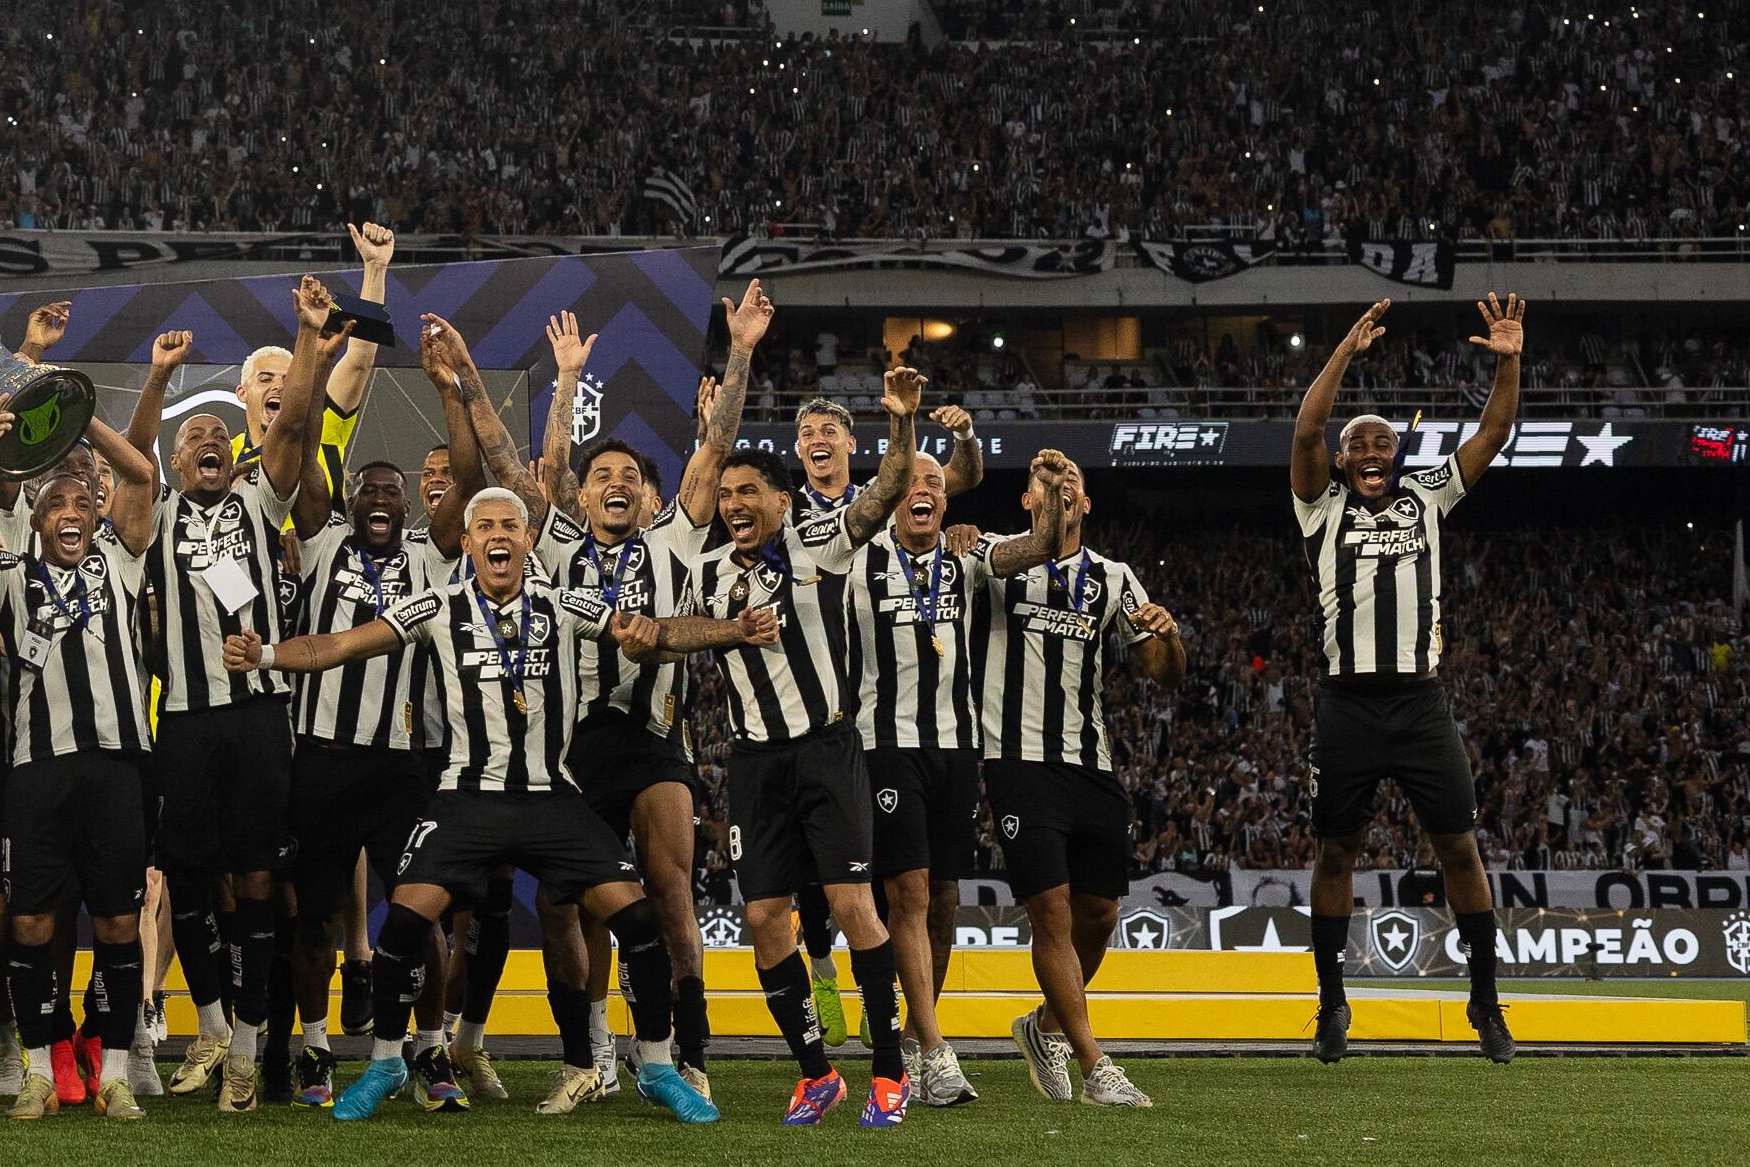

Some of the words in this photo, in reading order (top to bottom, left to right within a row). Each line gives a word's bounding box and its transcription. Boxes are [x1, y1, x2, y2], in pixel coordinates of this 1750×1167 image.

[1113, 424, 1200, 451] FIRE
[349, 573, 405, 595] PERECT
[395, 599, 436, 622] Centrum
[1029, 605, 1097, 626] PERFECT
[1044, 622, 1096, 641] MATCH
[497, 663, 550, 678] MTCH
